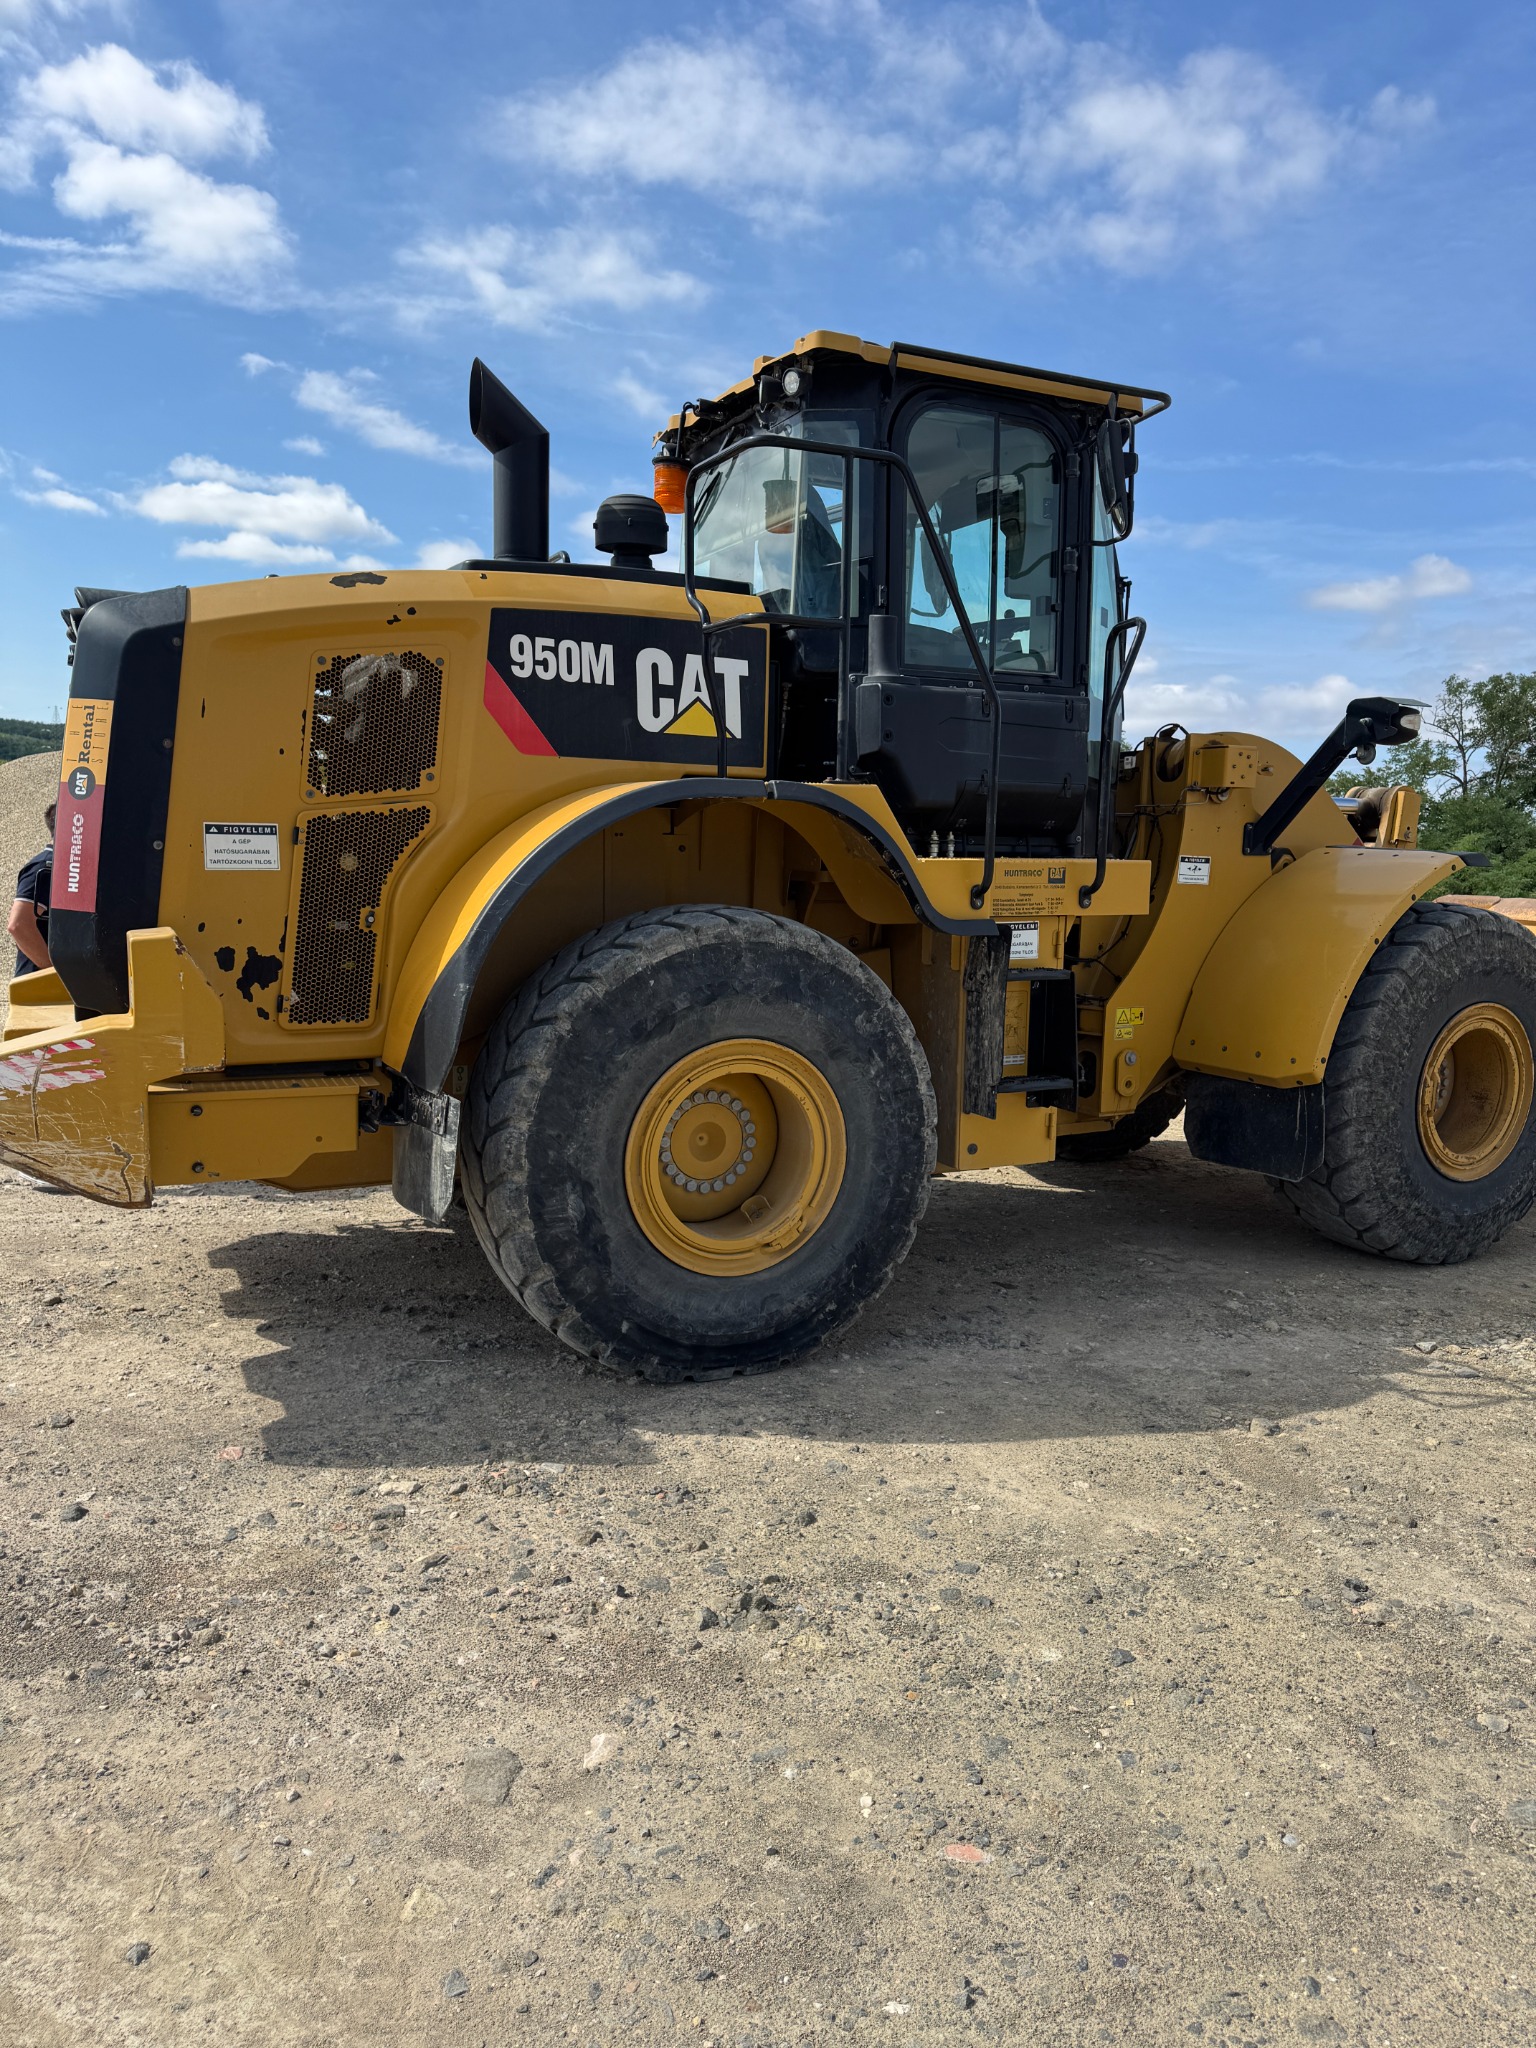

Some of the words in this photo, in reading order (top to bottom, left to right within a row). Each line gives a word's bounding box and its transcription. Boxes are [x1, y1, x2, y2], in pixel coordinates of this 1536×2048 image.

[509, 633, 615, 686] 950M
[636, 647, 749, 739] CAT
[78, 704, 96, 764] Rental
[74, 771, 89, 796] CAT
[223, 826, 276, 834] FIGYELEM!
[68, 813, 84, 893] HUNTRACO
[1004, 869, 1043, 877] HUNTRACO
[1050, 867, 1065, 878] CAT
